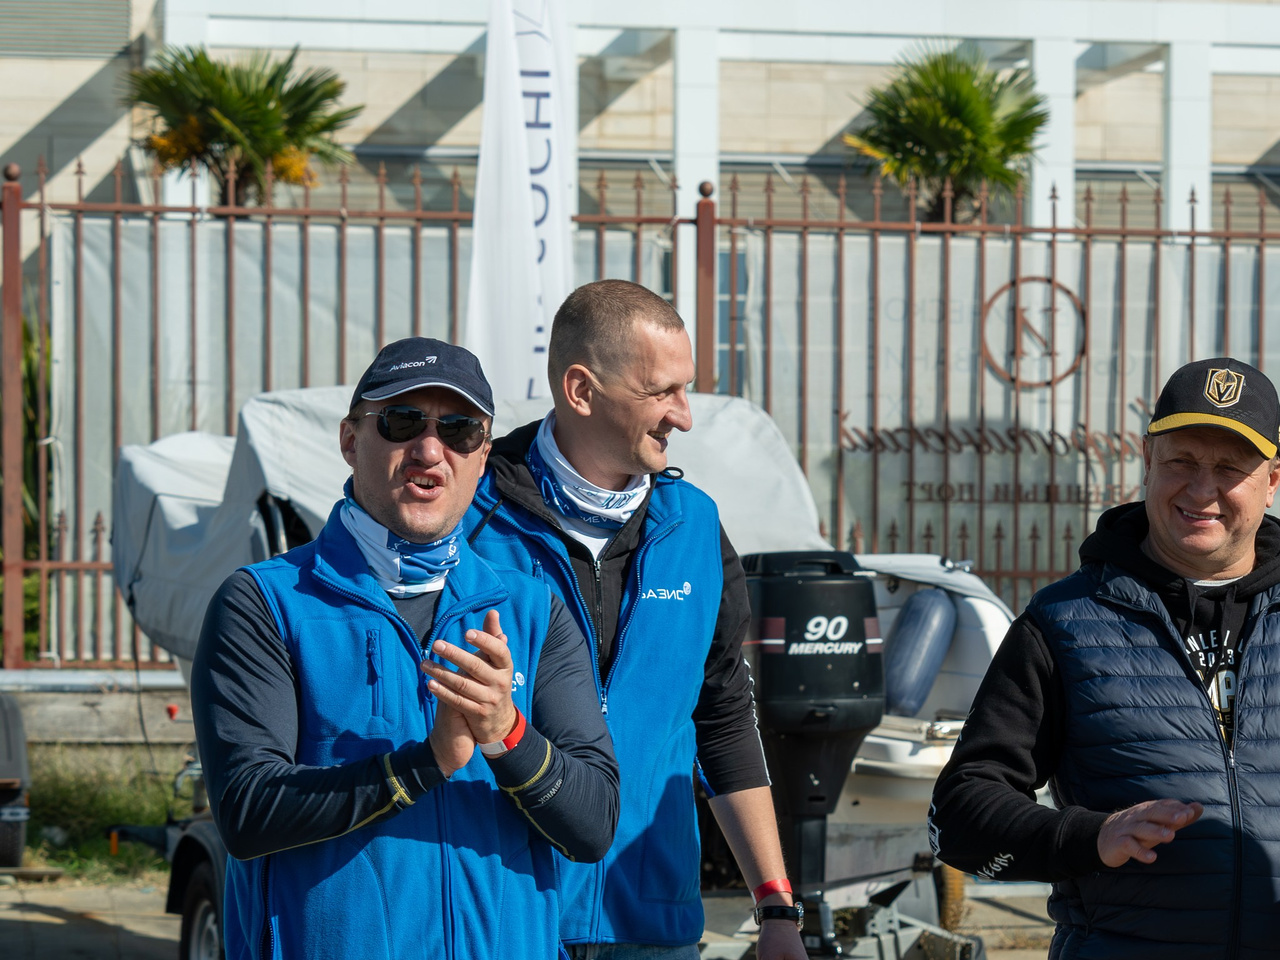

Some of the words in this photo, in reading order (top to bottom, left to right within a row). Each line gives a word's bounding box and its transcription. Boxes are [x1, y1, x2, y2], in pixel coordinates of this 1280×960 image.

[389, 361, 425, 372] Aviacon
[804, 615, 849, 641] 90
[788, 642, 863, 655] MERCURY
